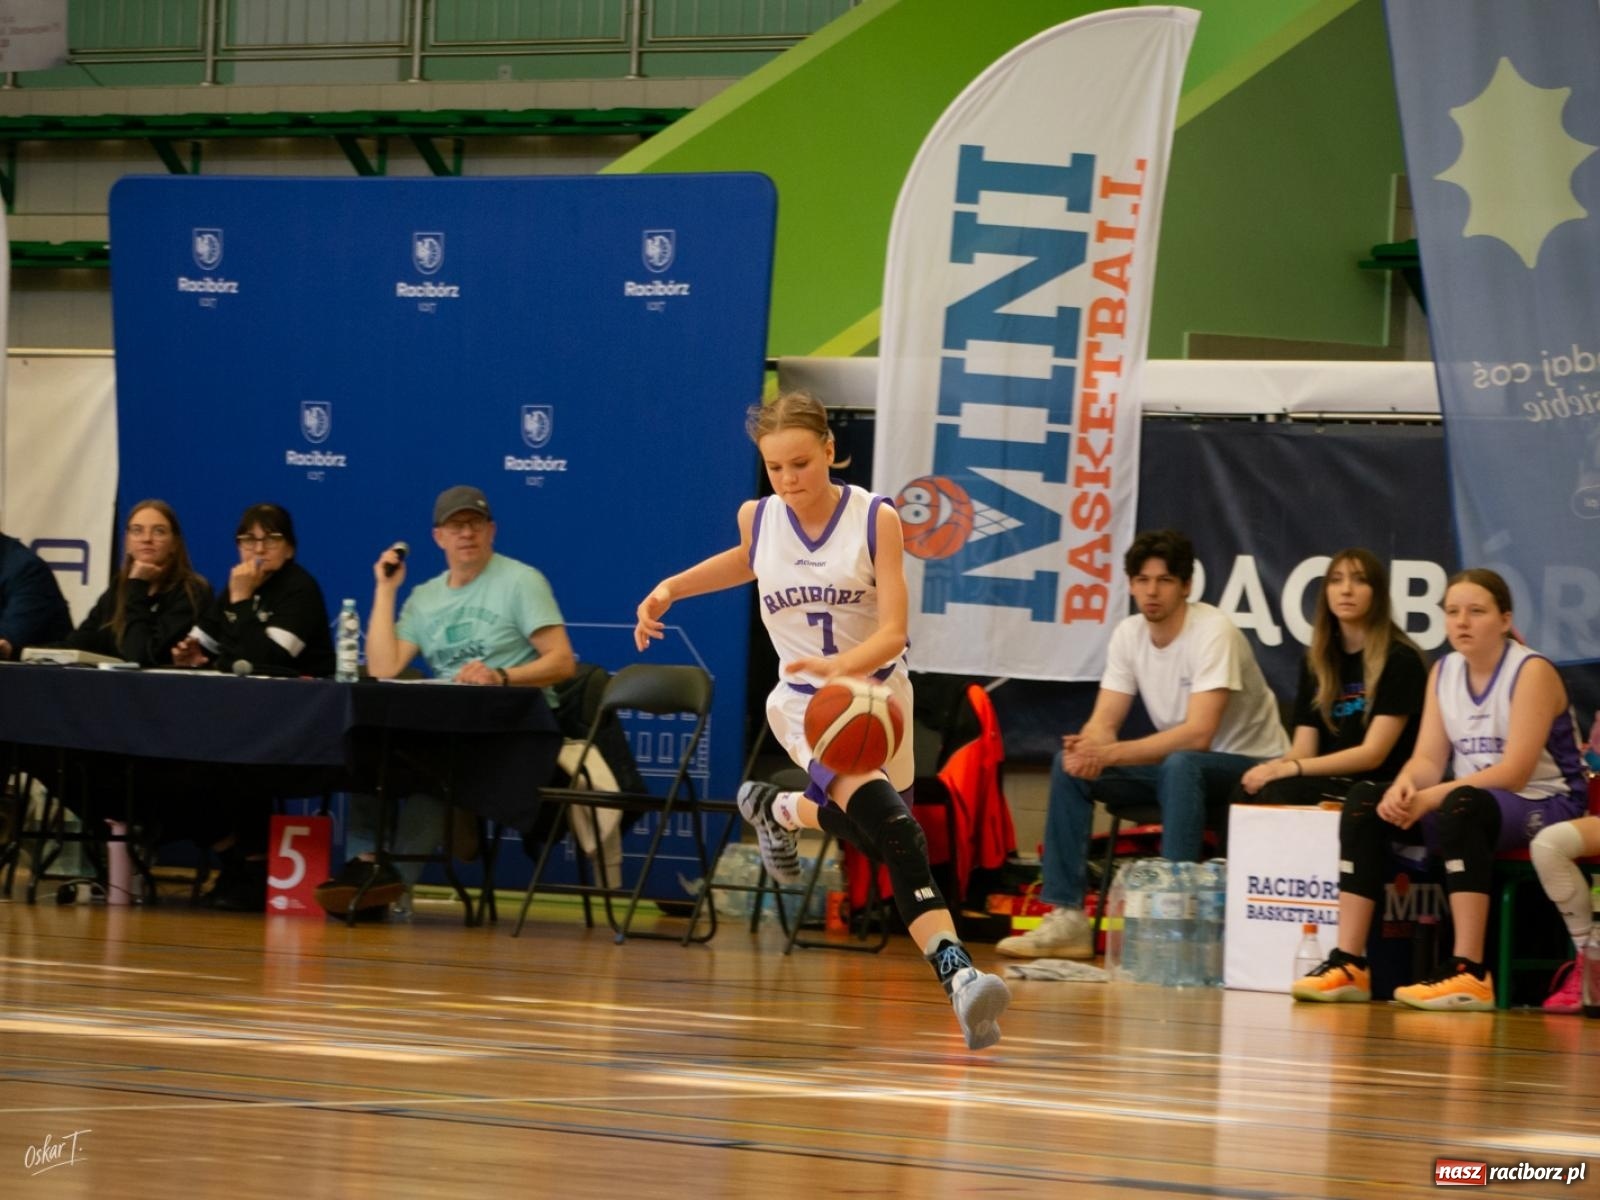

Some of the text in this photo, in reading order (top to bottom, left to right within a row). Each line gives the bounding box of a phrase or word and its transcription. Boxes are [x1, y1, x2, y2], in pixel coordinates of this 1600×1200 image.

[178, 277, 239, 293] Racibórz
[396, 282, 460, 297] Racibórz
[624, 280, 690, 296] Racibórz
[922, 144, 1096, 624] MINI
[1062, 158, 1147, 625] BASKETBALL
[286, 450, 346, 467] Racibórz
[505, 455, 567, 472] Racibórz
[763, 584, 866, 615] RACIBÓRZ
[806, 611, 839, 656] 7
[267, 825, 310, 890] 5
